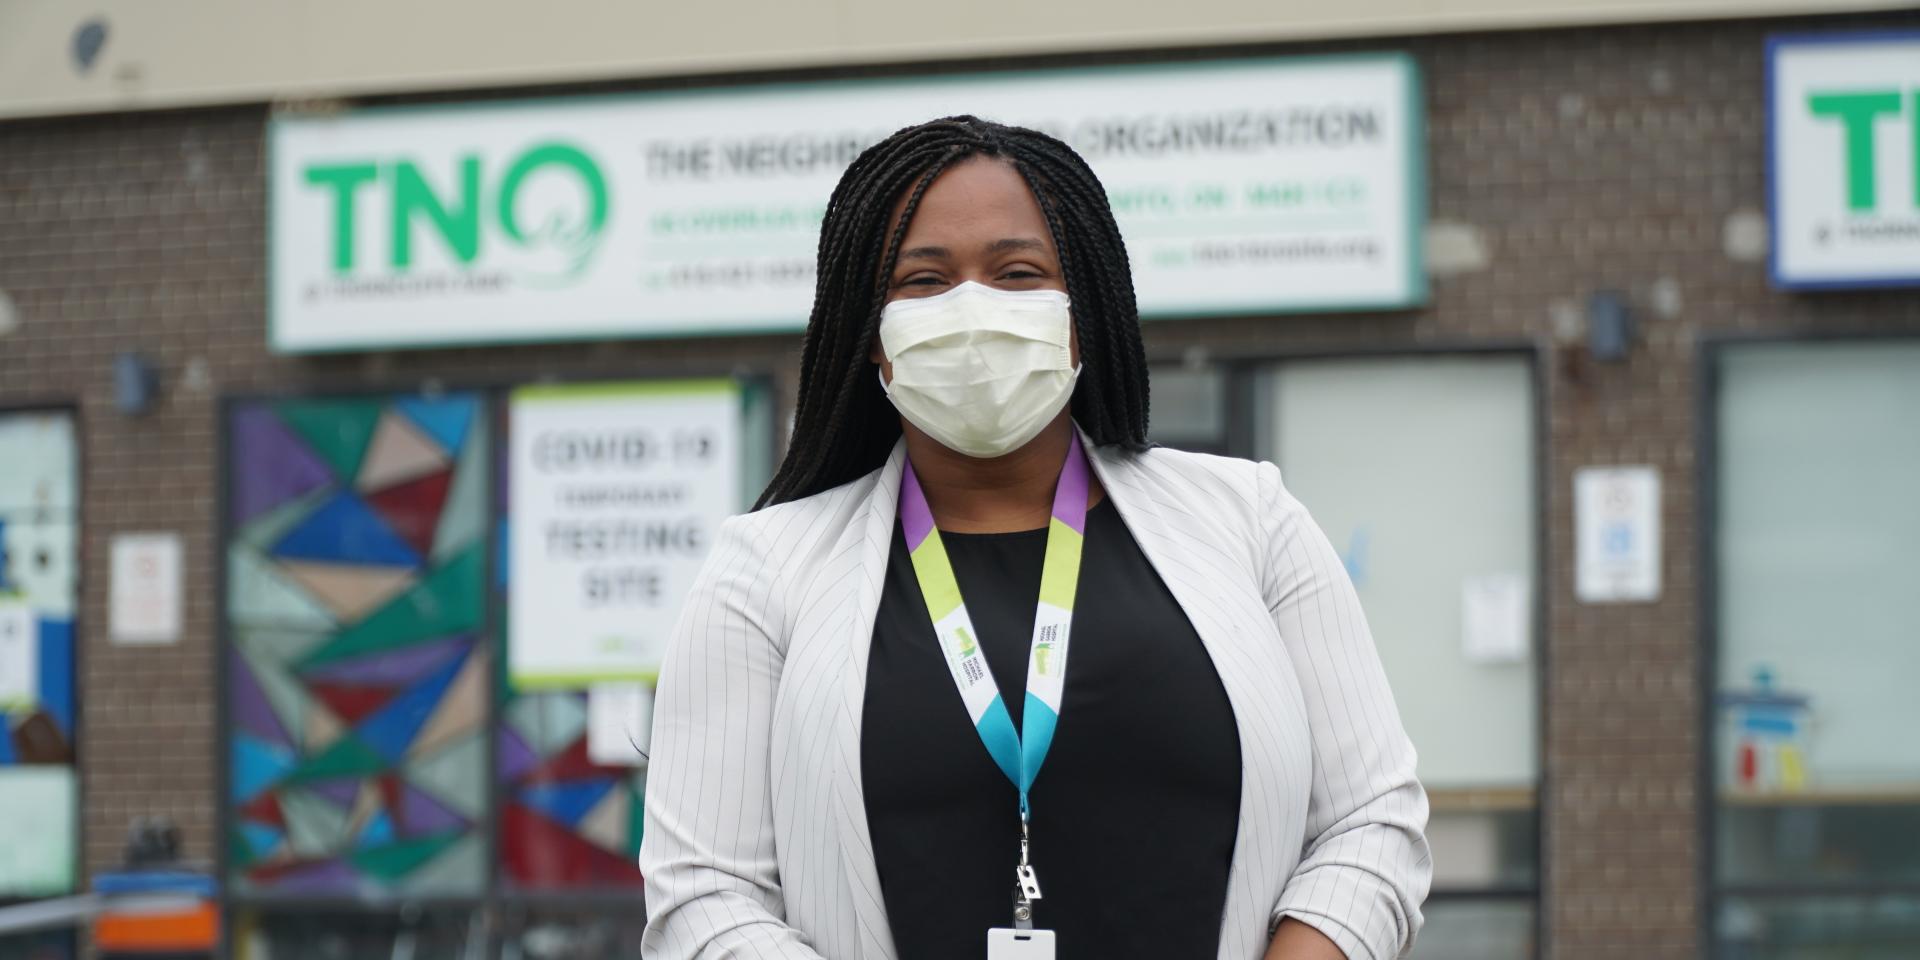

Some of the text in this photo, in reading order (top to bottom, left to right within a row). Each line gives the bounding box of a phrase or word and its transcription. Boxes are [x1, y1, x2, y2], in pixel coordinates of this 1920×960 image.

[645, 138, 713, 180] THE
[1072, 107, 1380, 157] ORGANIZATION
[1808, 91, 1920, 213] T
[303, 141, 609, 278] TNO
[532, 432, 713, 472] COVID-19
[545, 517, 707, 557] TESTING
[584, 570, 661, 606] SITE
[962, 662, 975, 687] HOSPITAL
[967, 659, 979, 681] GARRON
[972, 656, 984, 680] MICHAEL
